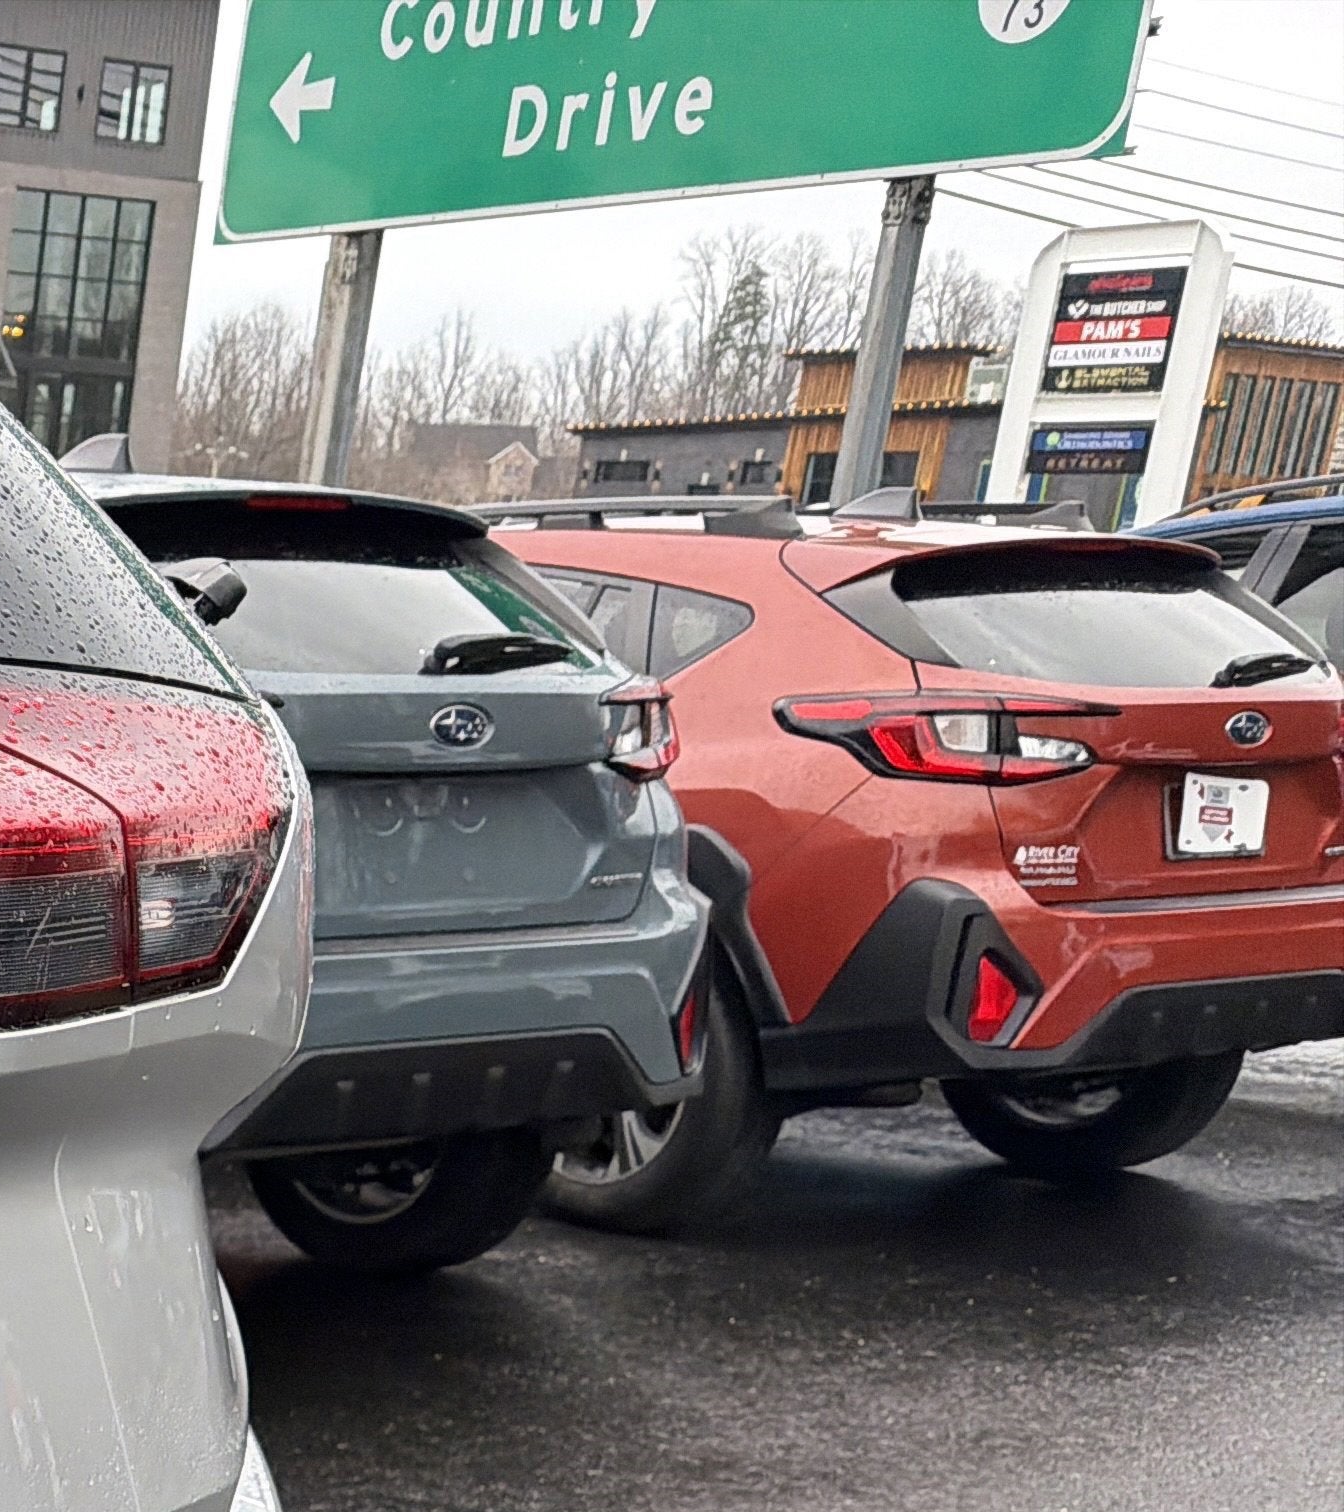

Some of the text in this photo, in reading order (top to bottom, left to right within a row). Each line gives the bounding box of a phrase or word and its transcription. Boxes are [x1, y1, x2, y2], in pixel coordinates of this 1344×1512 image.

[502, 71, 713, 158] Drive
[1103, 300, 1147, 316] BUTCHER
[1079, 318, 1143, 342] PAM'S
[1053, 346, 1162, 361] GLAMOUR NAILS
